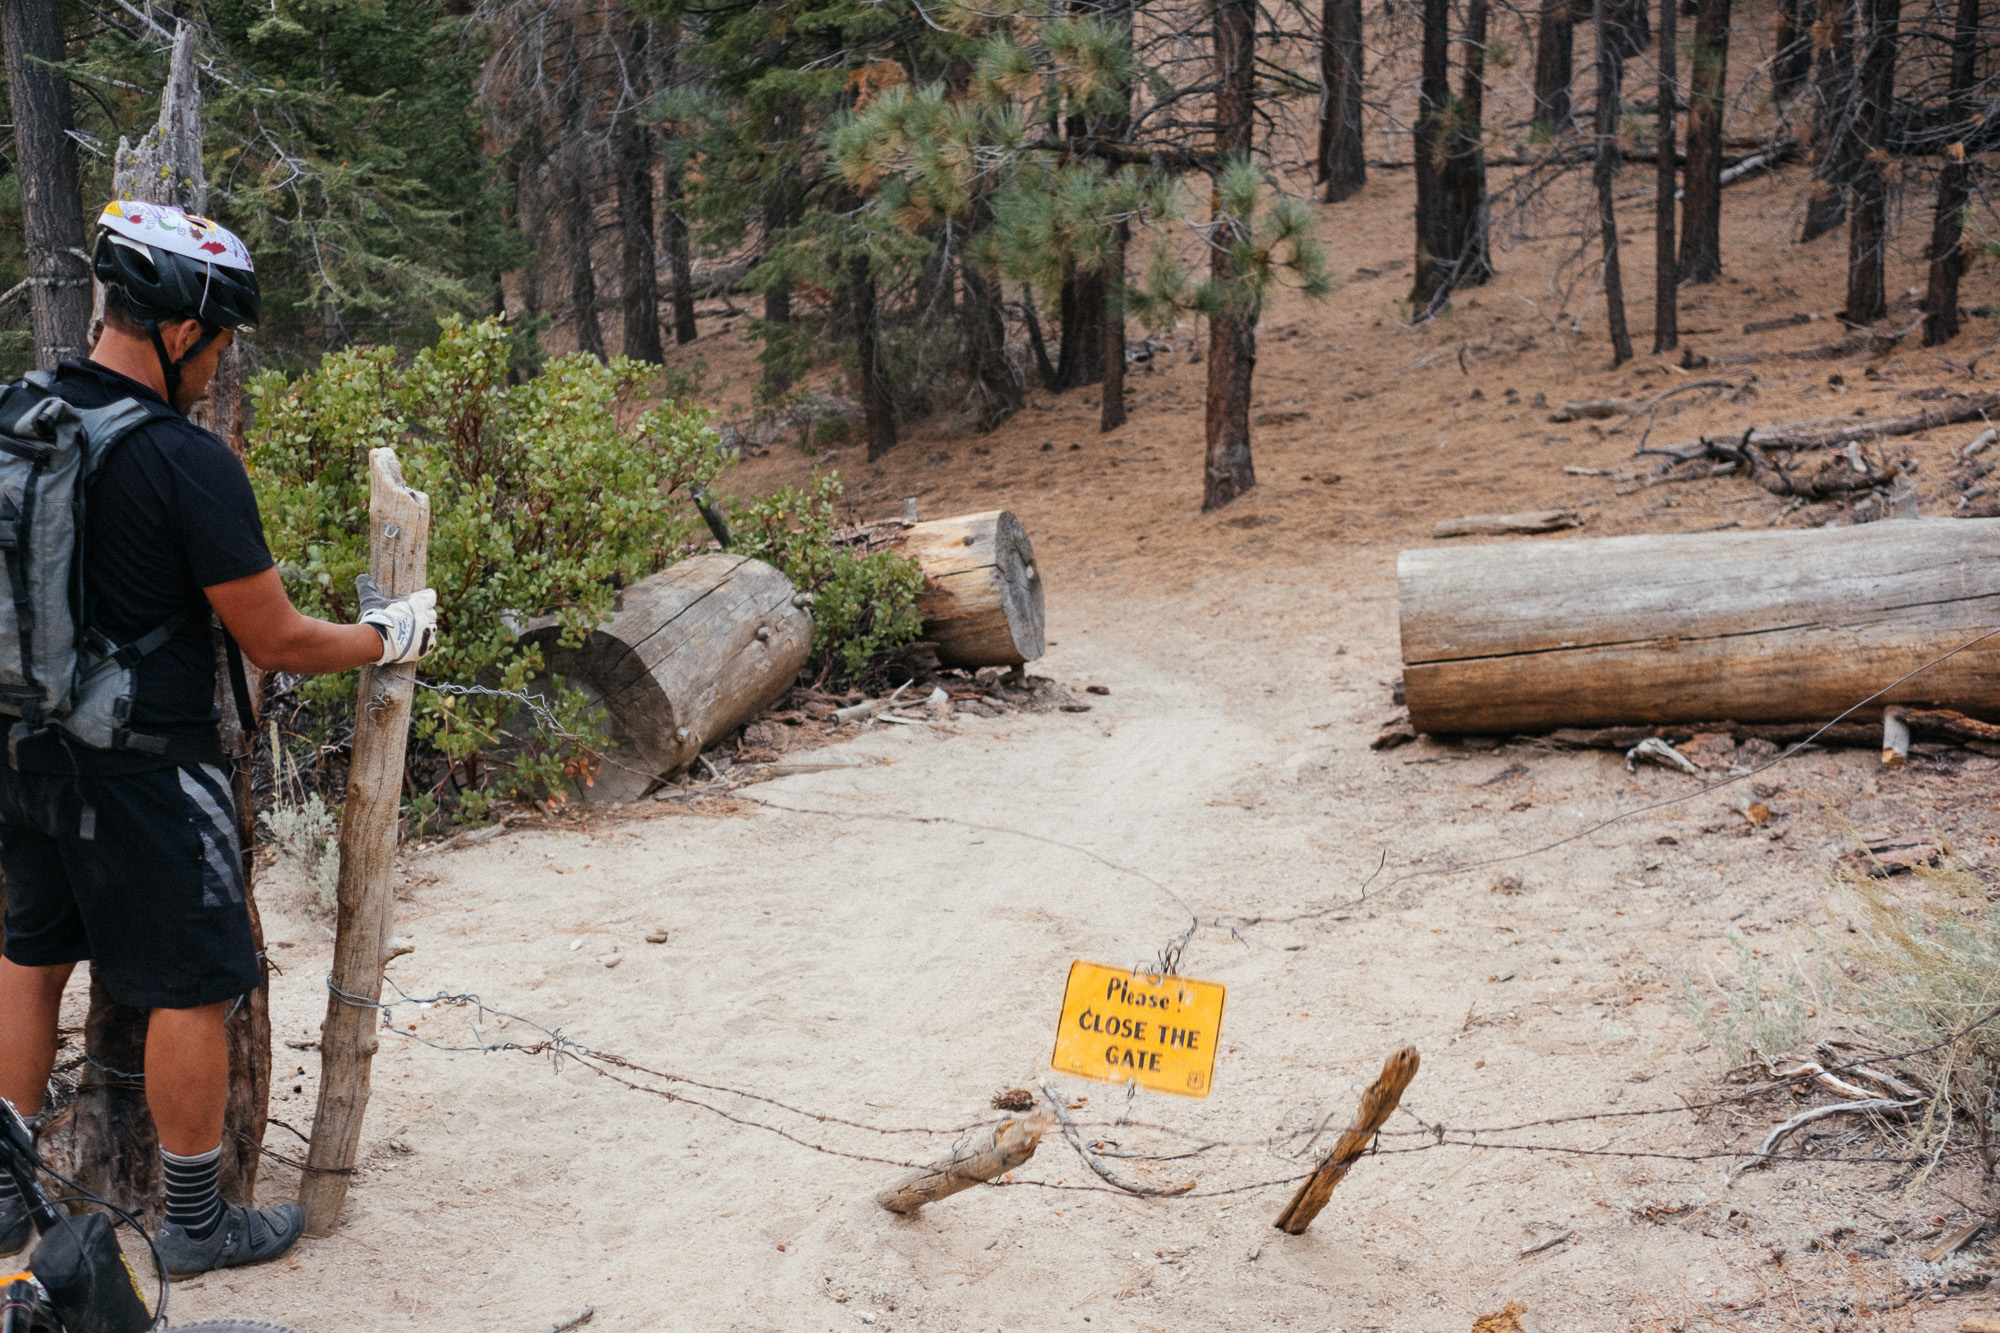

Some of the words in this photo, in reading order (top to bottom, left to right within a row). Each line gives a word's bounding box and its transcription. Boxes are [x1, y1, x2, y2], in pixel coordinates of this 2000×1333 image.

[1079, 1007, 1148, 1041] CLOSE
[1158, 1025, 1201, 1050] THE
[1105, 1045, 1163, 1073] GATE
